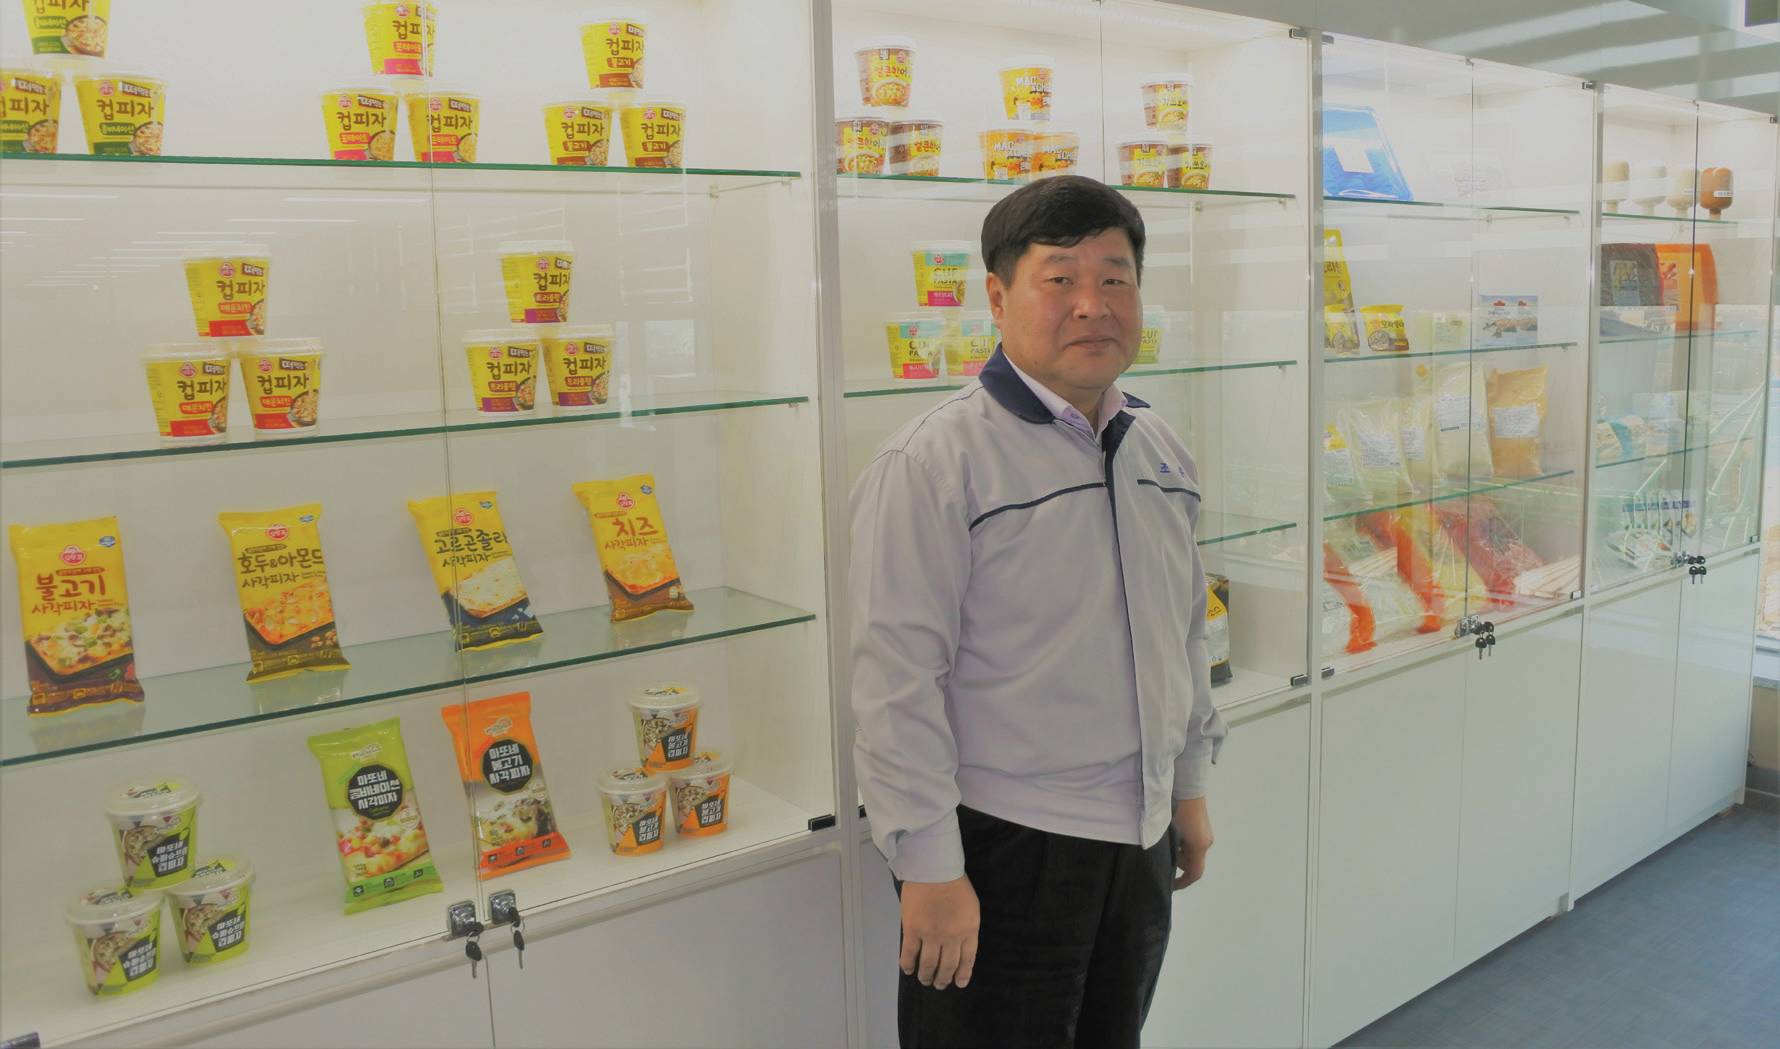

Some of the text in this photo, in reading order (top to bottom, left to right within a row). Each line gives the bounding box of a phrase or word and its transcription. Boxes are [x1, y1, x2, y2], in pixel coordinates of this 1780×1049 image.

[605, 37, 645, 56] 컵피자
[611, 57, 631, 68] 불고기
[97, 99, 155, 121] 컵피자
[0, 121, 29, 133] 비네이션
[336, 111, 387, 131] 컵피자
[426, 114, 473, 133] 컵피자
[341, 133, 369, 143] 포테이토
[561, 121, 604, 139] 컵피자
[641, 122, 682, 140] 컵피자
[430, 135, 458, 145] 포테이토
[566, 141, 587, 151] 불고기
[646, 142, 666, 152] 불고기
[994, 141, 1014, 152] MAC
[933, 267, 958, 278] CUP
[216, 279, 266, 301] 컵피자
[533, 272, 570, 291] 컵피자
[220, 303, 251, 313] 매운치킨
[487, 361, 532, 381] 컵피자
[563, 356, 606, 375] 컵피자
[177, 378, 227, 401] 컵피자
[257, 373, 310, 395] 컵피자
[181, 403, 213, 413] 매운치킨
[262, 397, 292, 407] 매운치킨
[612, 516, 659, 537] 치즈
[434, 528, 509, 554] 고르곤졸라
[604, 537, 649, 551] 사각피자
[237, 548, 324, 575] 호두&아몬드
[442, 553, 491, 568] 사각피자
[35, 573, 106, 602] 불고기
[242, 572, 300, 589] 사각피자
[32, 599, 97, 616] 사각피자
[488, 743, 520, 760] 마또네
[667, 740, 689, 750] 불고기
[667, 748, 689, 758] 컵피자
[491, 754, 524, 772] 불고기
[356, 769, 388, 786] 마또네
[489, 764, 531, 785] 사각피자
[349, 778, 401, 800] 콤비네이션
[357, 791, 398, 810] 사각피자
[701, 813, 722, 824] 컵피자
[638, 830, 660, 842] 컵피자
[158, 856, 185, 873] 컵피자
[218, 930, 242, 948] 컵피자
[129, 959, 154, 977] 컵피자
